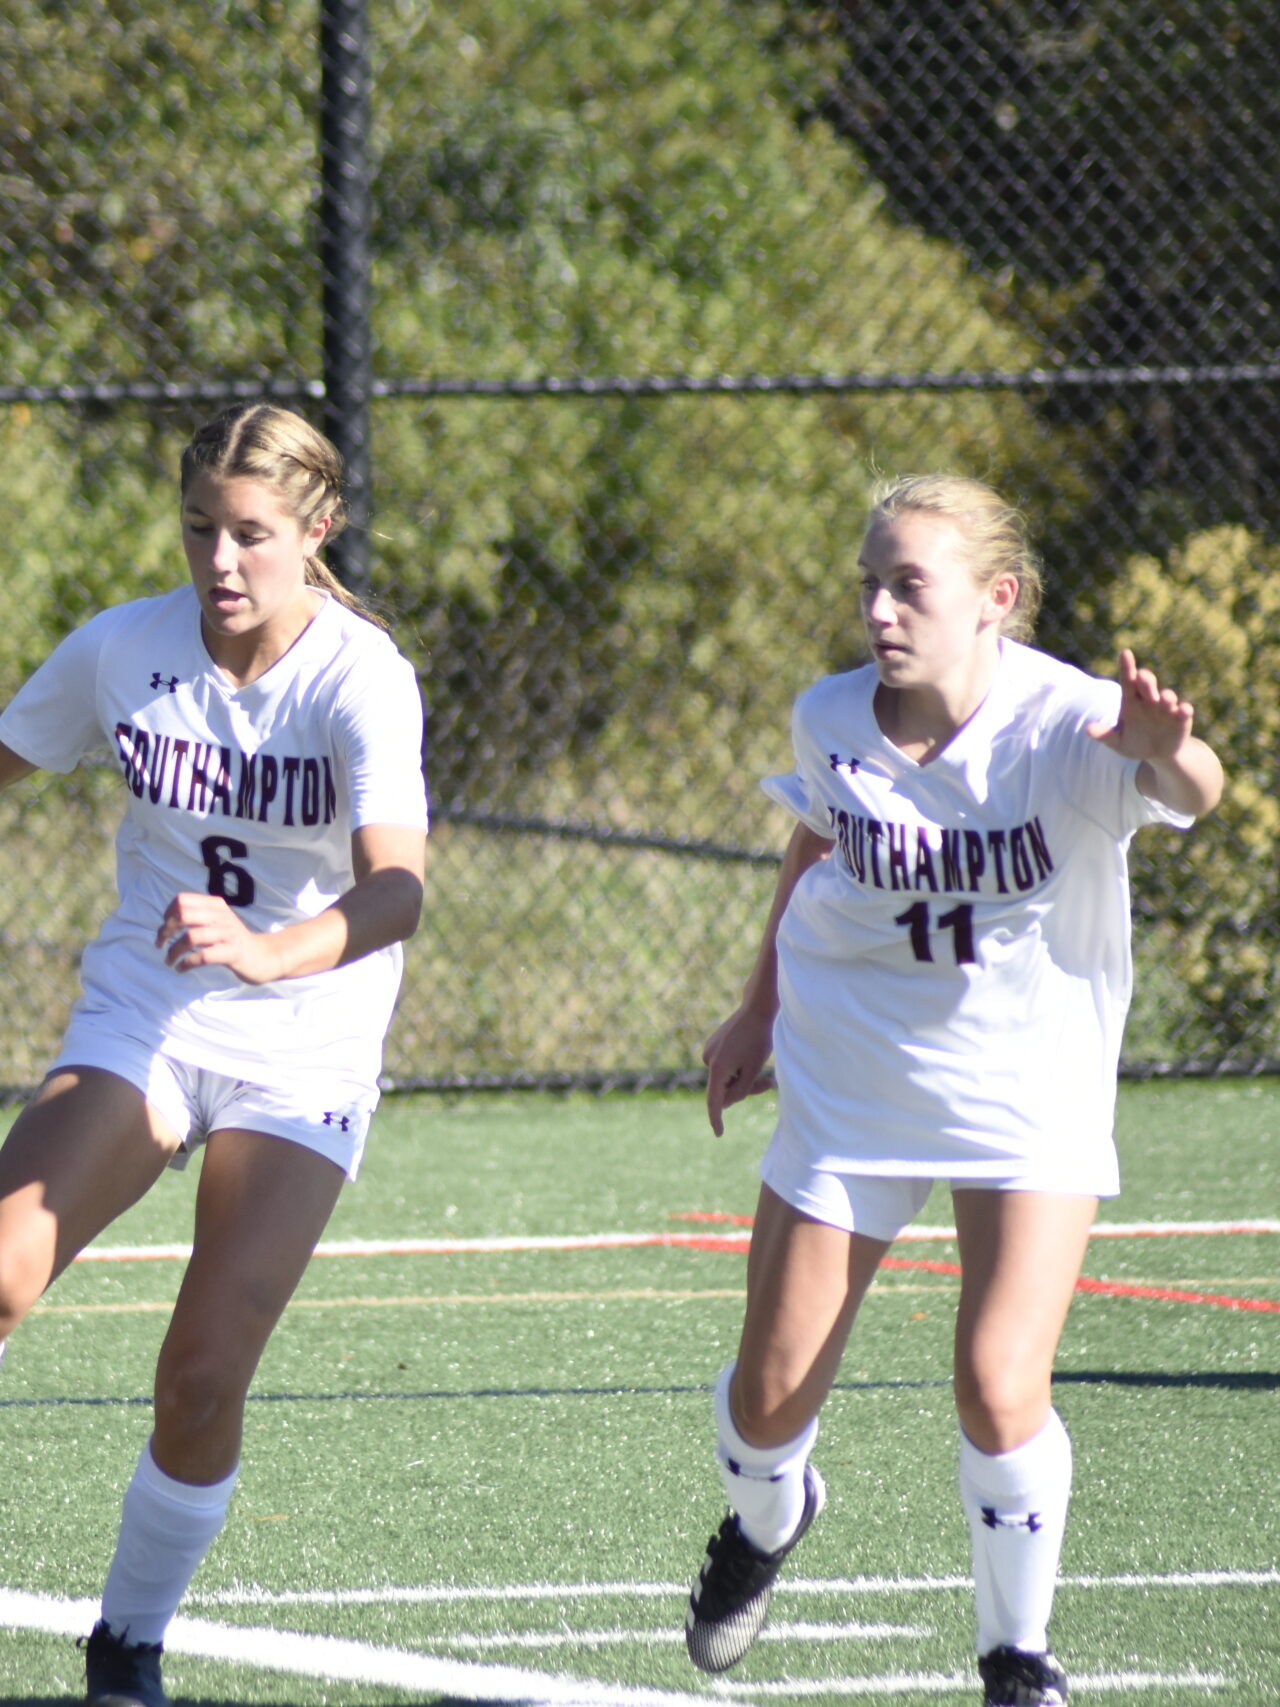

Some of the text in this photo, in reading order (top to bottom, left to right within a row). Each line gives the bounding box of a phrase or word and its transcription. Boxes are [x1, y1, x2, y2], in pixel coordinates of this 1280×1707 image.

[114, 722, 337, 826] SOUTHAMPTON
[200, 834, 255, 907] 6
[894, 901, 977, 965] 11
